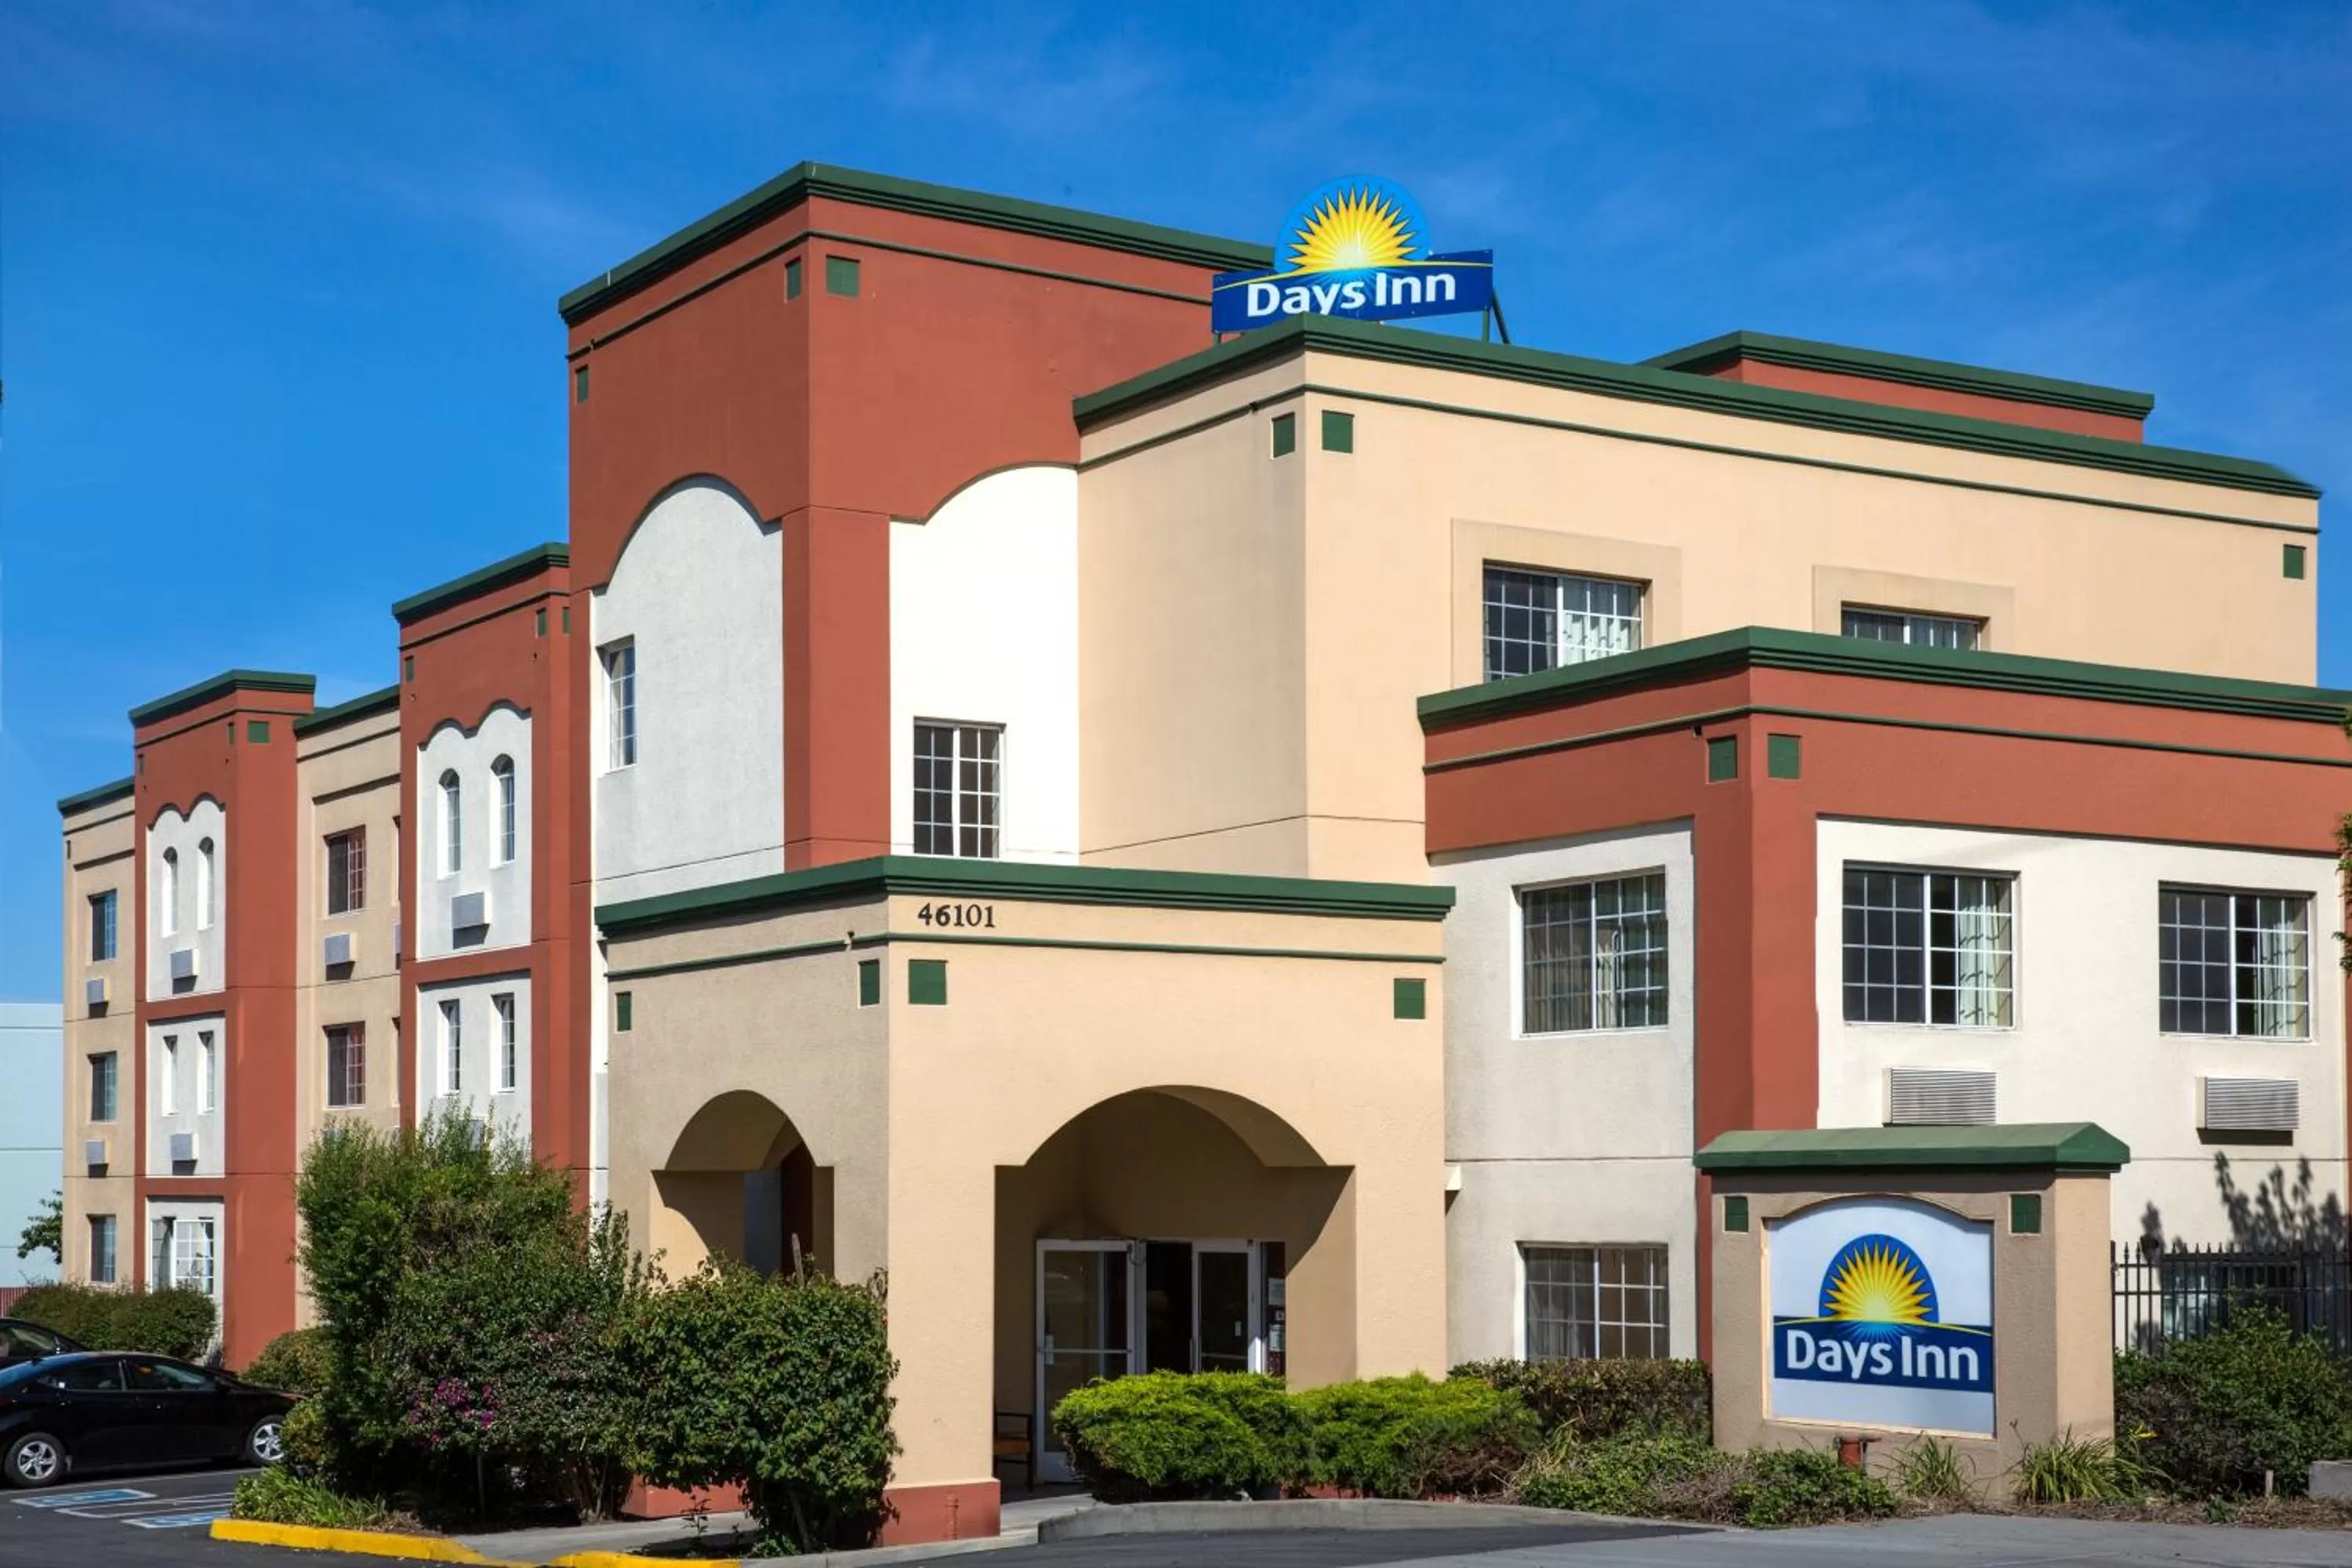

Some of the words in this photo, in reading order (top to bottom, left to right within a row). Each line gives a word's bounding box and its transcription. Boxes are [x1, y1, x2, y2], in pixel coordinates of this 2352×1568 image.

[1247, 281, 1367, 317] Days
[1374, 272, 1456, 307] Inn
[917, 902, 996, 928] 46101
[1787, 1329, 1894, 1380] Days
[1901, 1335, 1980, 1381] Inn
